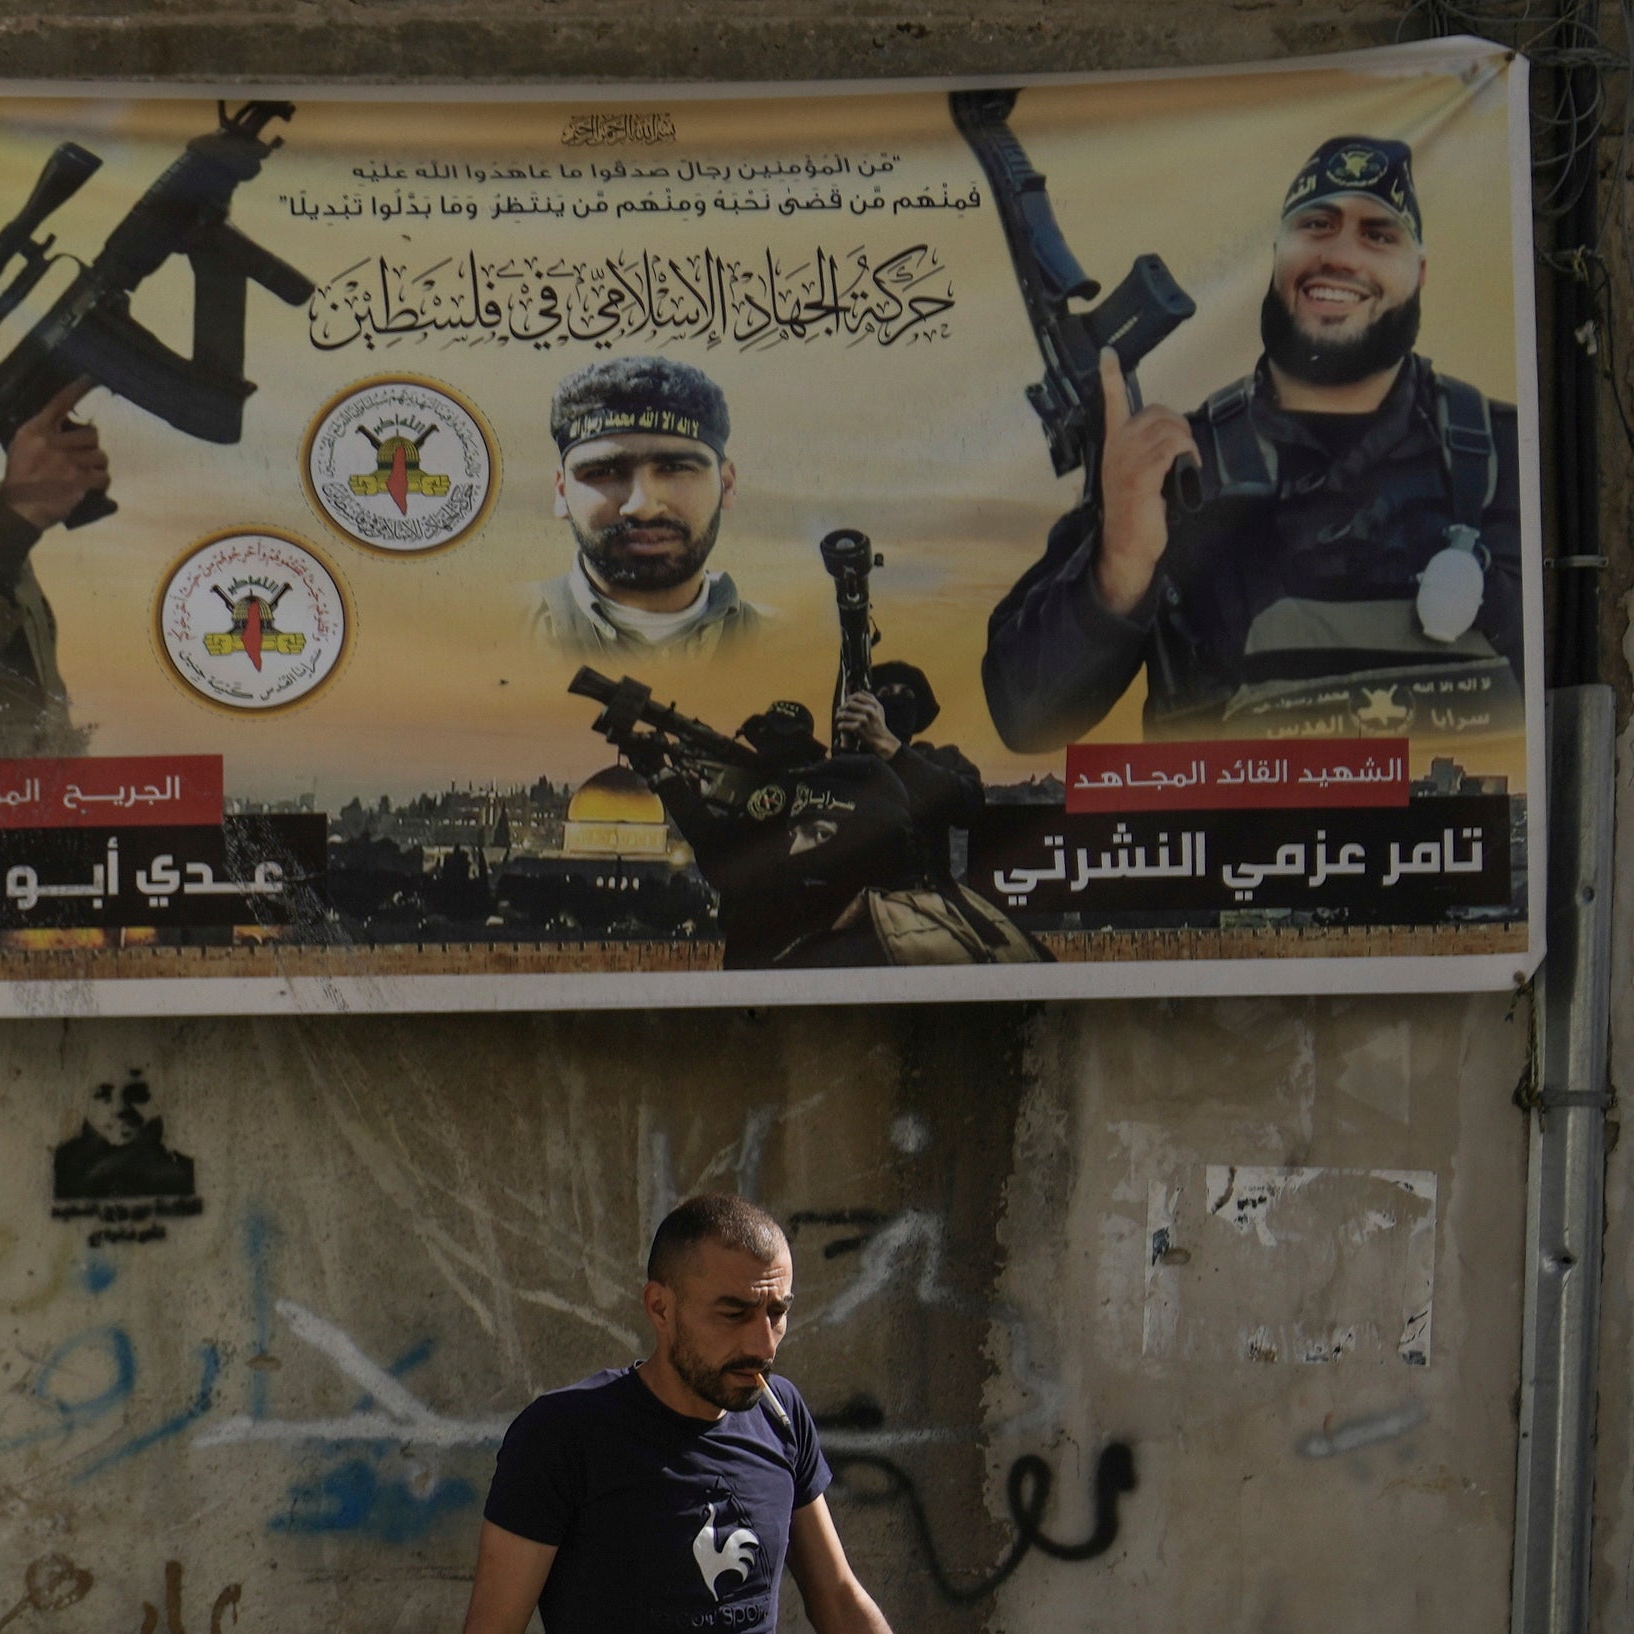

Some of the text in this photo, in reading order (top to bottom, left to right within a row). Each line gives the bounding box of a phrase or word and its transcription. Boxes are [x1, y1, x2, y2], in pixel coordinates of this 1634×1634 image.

[62, 775, 180, 810] الجريح
[1073, 757, 1403, 792] الشهيد القائد المجاهد
[5, 836, 119, 910] أبو
[135, 852, 284, 907] عدي
[993, 823, 1483, 906] تامر عزمي النشرتي
